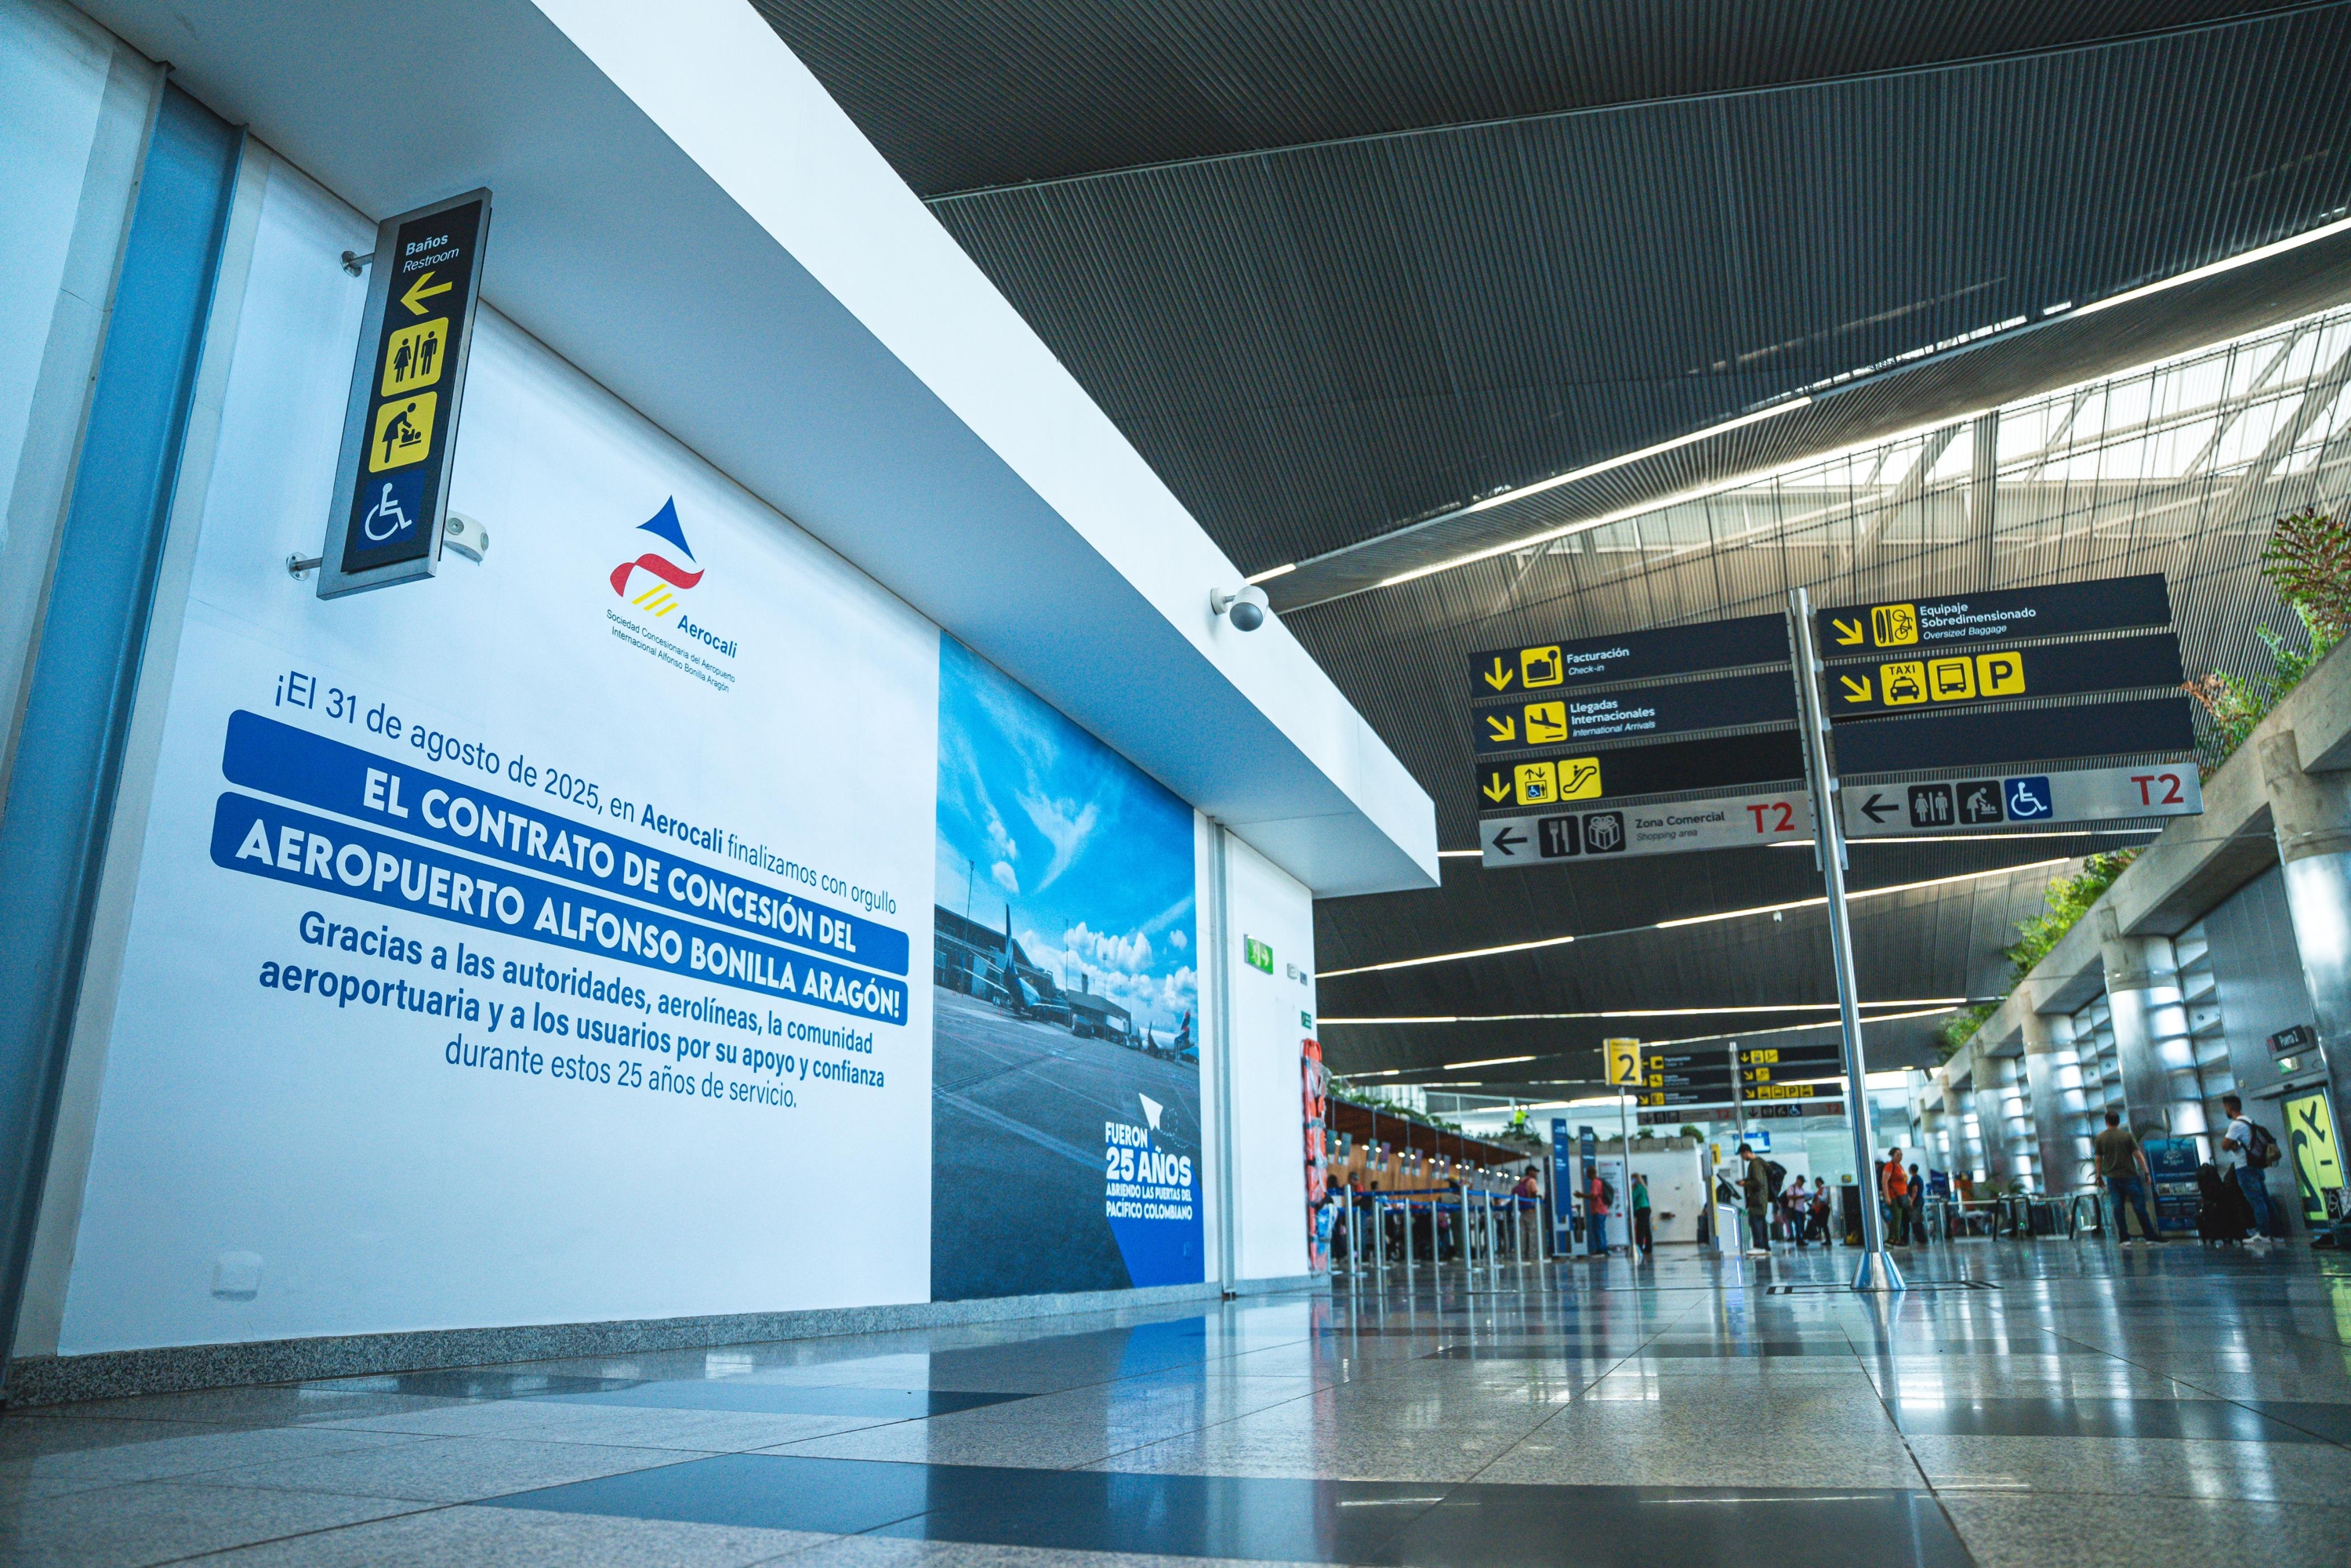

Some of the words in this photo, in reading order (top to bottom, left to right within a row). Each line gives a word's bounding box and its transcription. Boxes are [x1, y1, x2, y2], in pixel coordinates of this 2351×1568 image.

[406, 235, 448, 256] Baños
[403, 249, 459, 273] Restroom
[1920, 603, 1968, 617] Equipaje
[1921, 608, 2036, 628] Sobredimensionado
[677, 615, 738, 659] Aerocali
[1924, 628, 1965, 640] Oversized
[1968, 624, 2007, 636] Baggage
[607, 610, 640, 634] Sociedad
[641, 627, 688, 659] Concesionaria
[691, 653, 700, 665] del
[702, 659, 735, 683] Aeropuerto
[1567, 648, 1629, 664] Facturación
[612, 626, 656, 655] Internacional
[658, 650, 682, 669] Alfonso
[684, 664, 706, 681] Bonilla
[707, 675, 728, 693] Aragón
[1569, 664, 1604, 675] Check-in
[1888, 665, 1915, 676] TAXI
[1990, 661, 2012, 689] P
[1570, 699, 1618, 714] Llegadas
[1571, 707, 1655, 724] Internacionales
[1573, 723, 1623, 737] International
[1625, 720, 1655, 731] Arrivals
[275, 671, 316, 710] ¡El
[326, 688, 356, 724] 31
[366, 702, 401, 739] de
[411, 724, 500, 774] agosto
[508, 755, 536, 787] de
[546, 768, 602, 815] 2025,
[610, 797, 633, 822] en
[641, 804, 722, 854] Aerocali
[728, 833, 816, 887] finalizamos
[822, 874, 846, 898] con
[851, 885, 896, 915] orgullo
[2131, 773, 2183, 805] T2
[1635, 818, 1663, 829] Zona
[1667, 811, 1725, 826] Comercial
[1747, 802, 1794, 833] T2
[1637, 831, 1676, 842] Shopping
[363, 767, 408, 818] EL
[422, 789, 614, 877] CONTRATO
[623, 851, 659, 894] DE
[667, 868, 812, 940] CONCESIÓN
[819, 917, 856, 953] DEL
[236, 818, 524, 925] AEROPUERTO
[534, 897, 682, 964] ALFONSO
[691, 938, 796, 993] BONILLA
[802, 968, 899, 1018] ARAGÓN!
[299, 911, 422, 964] Gracias
[431, 946, 447, 970] a
[457, 942, 495, 979] las
[502, 960, 651, 1014] autoridades,
[658, 993, 762, 1036] aerolíneas,
[768, 1011, 782, 1036] la
[787, 1018, 873, 1054] comunidad
[259, 960, 480, 1022] aeroportuaria
[488, 1000, 503, 1033] y
[510, 1007, 524, 1029] a
[534, 1002, 569, 1036] los
[577, 1018, 670, 1054] usuarios
[677, 1033, 709, 1062] por
[716, 1041, 736, 1065] su
[742, 1046, 795, 1077] apoyo
[800, 1057, 809, 1080] y
[813, 1058, 884, 1087] confianza
[445, 1033, 543, 1076] durante
[551, 1054, 611, 1084] estos
[618, 1060, 641, 1088] 25
[649, 1065, 695, 1097] años
[702, 1072, 723, 1098] de
[729, 1077, 796, 1109] servicio.
[1618, 1054, 1635, 1080] 2
[1105, 1122, 1148, 1149] FUERON
[1106, 1146, 1134, 1181] 25
[1137, 1145, 1192, 1186] AÑOS
[1106, 1182, 1141, 1199] ABRIENDO
[1142, 1186, 1154, 1200] LAS
[1156, 1187, 1181, 1201] PUERTAS
[1181, 1189, 1192, 1202] DEL
[1106, 1198, 1142, 1218] PACÍFICO
[1144, 1203, 1192, 1220] COLOMBIANO
